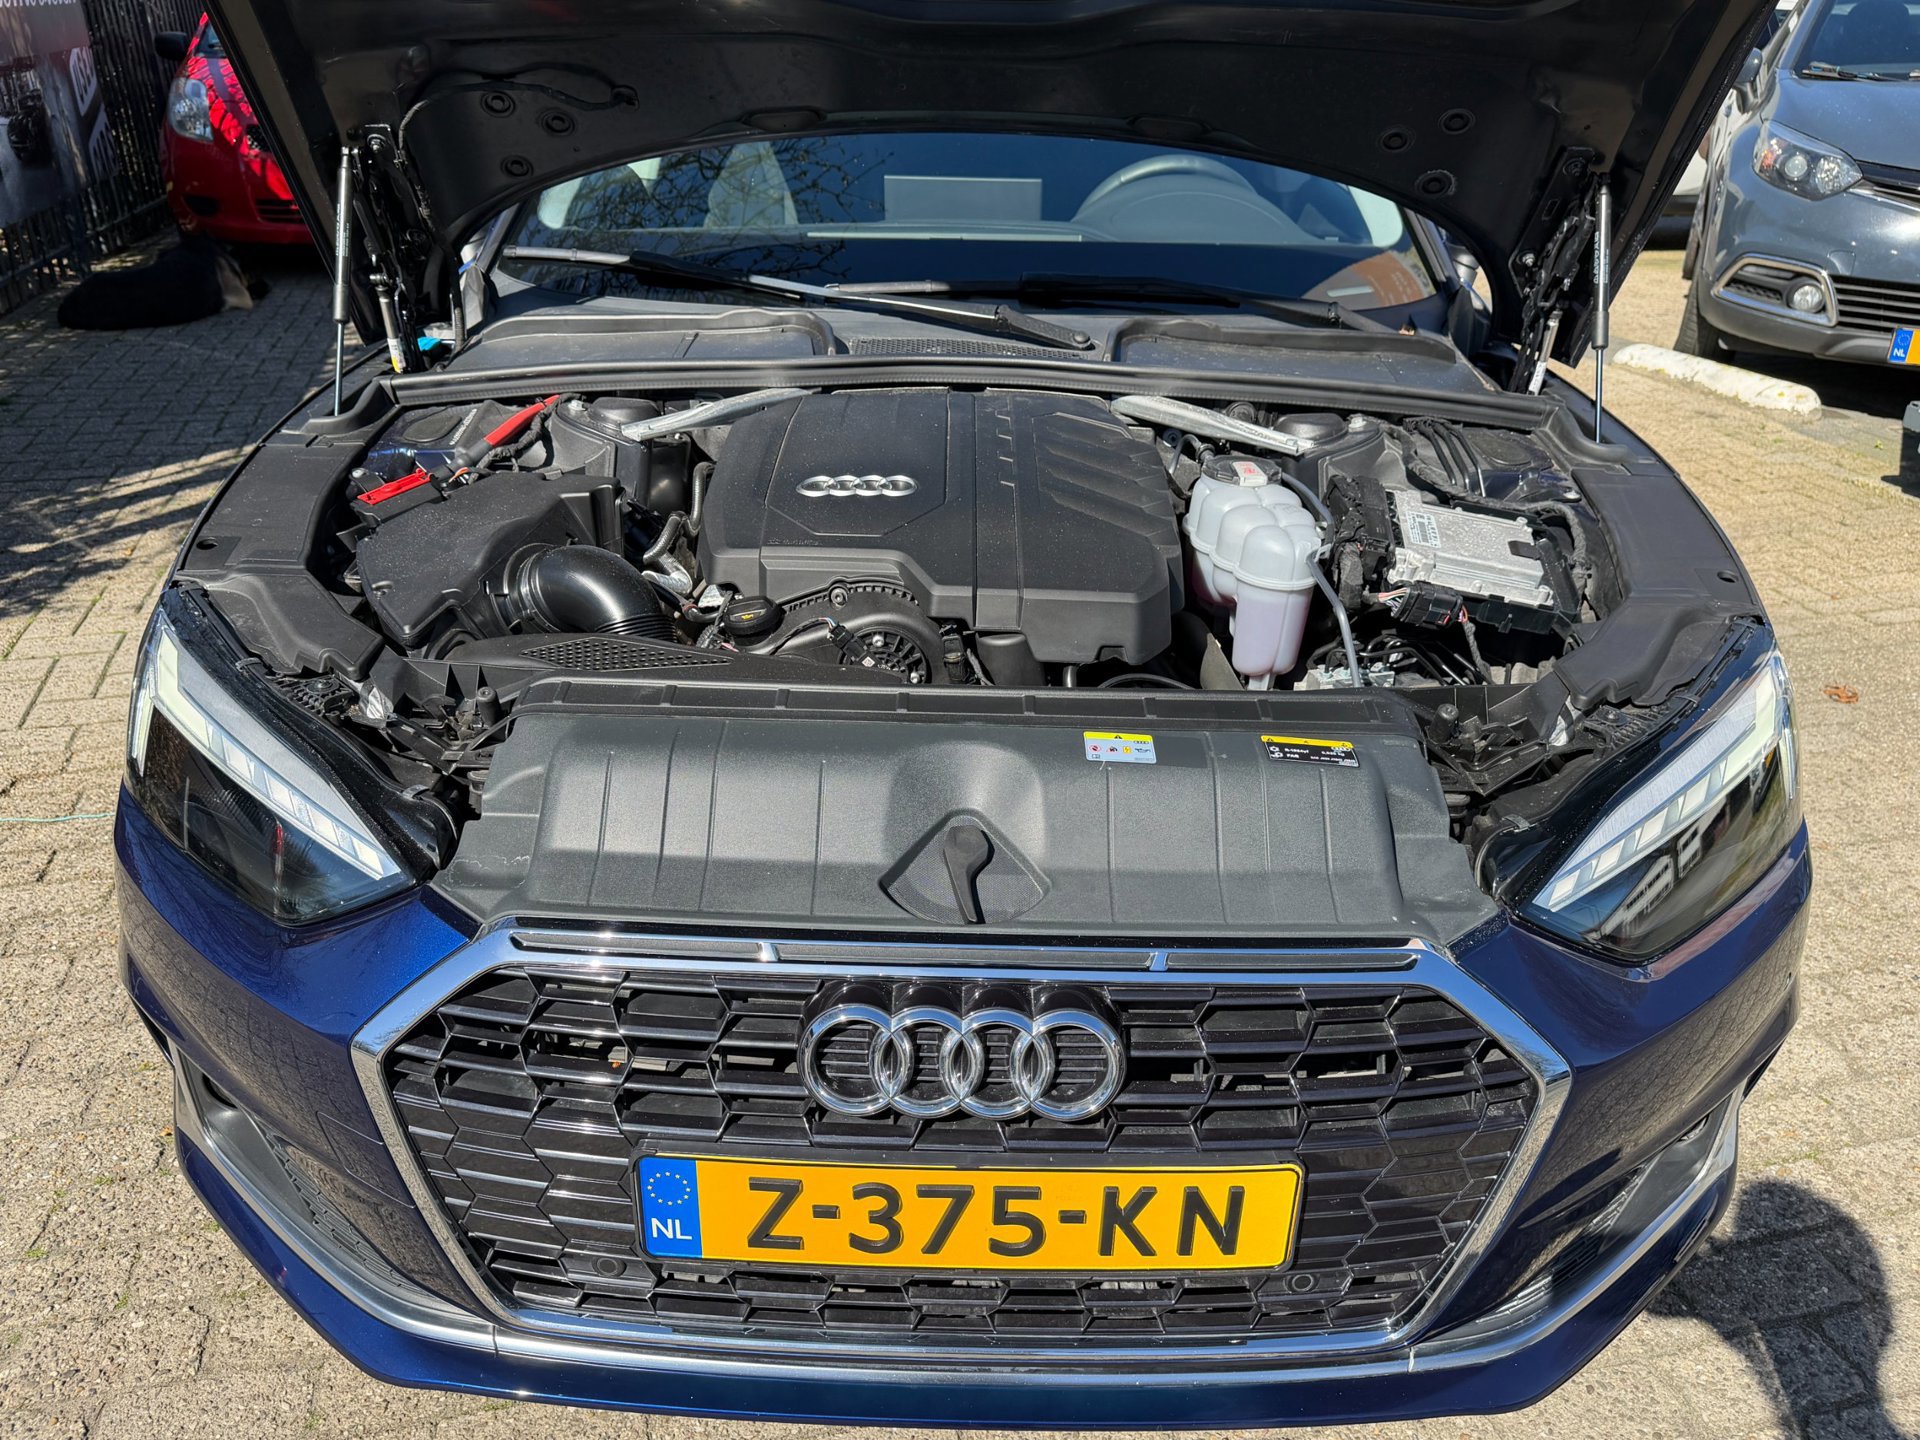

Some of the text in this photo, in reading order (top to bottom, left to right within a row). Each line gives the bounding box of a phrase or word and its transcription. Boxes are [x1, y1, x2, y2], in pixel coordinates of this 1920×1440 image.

[1893, 347, 1905, 357] NL
[747, 1176, 1247, 1257] Z-375-KN
[651, 1217, 693, 1241] NL
